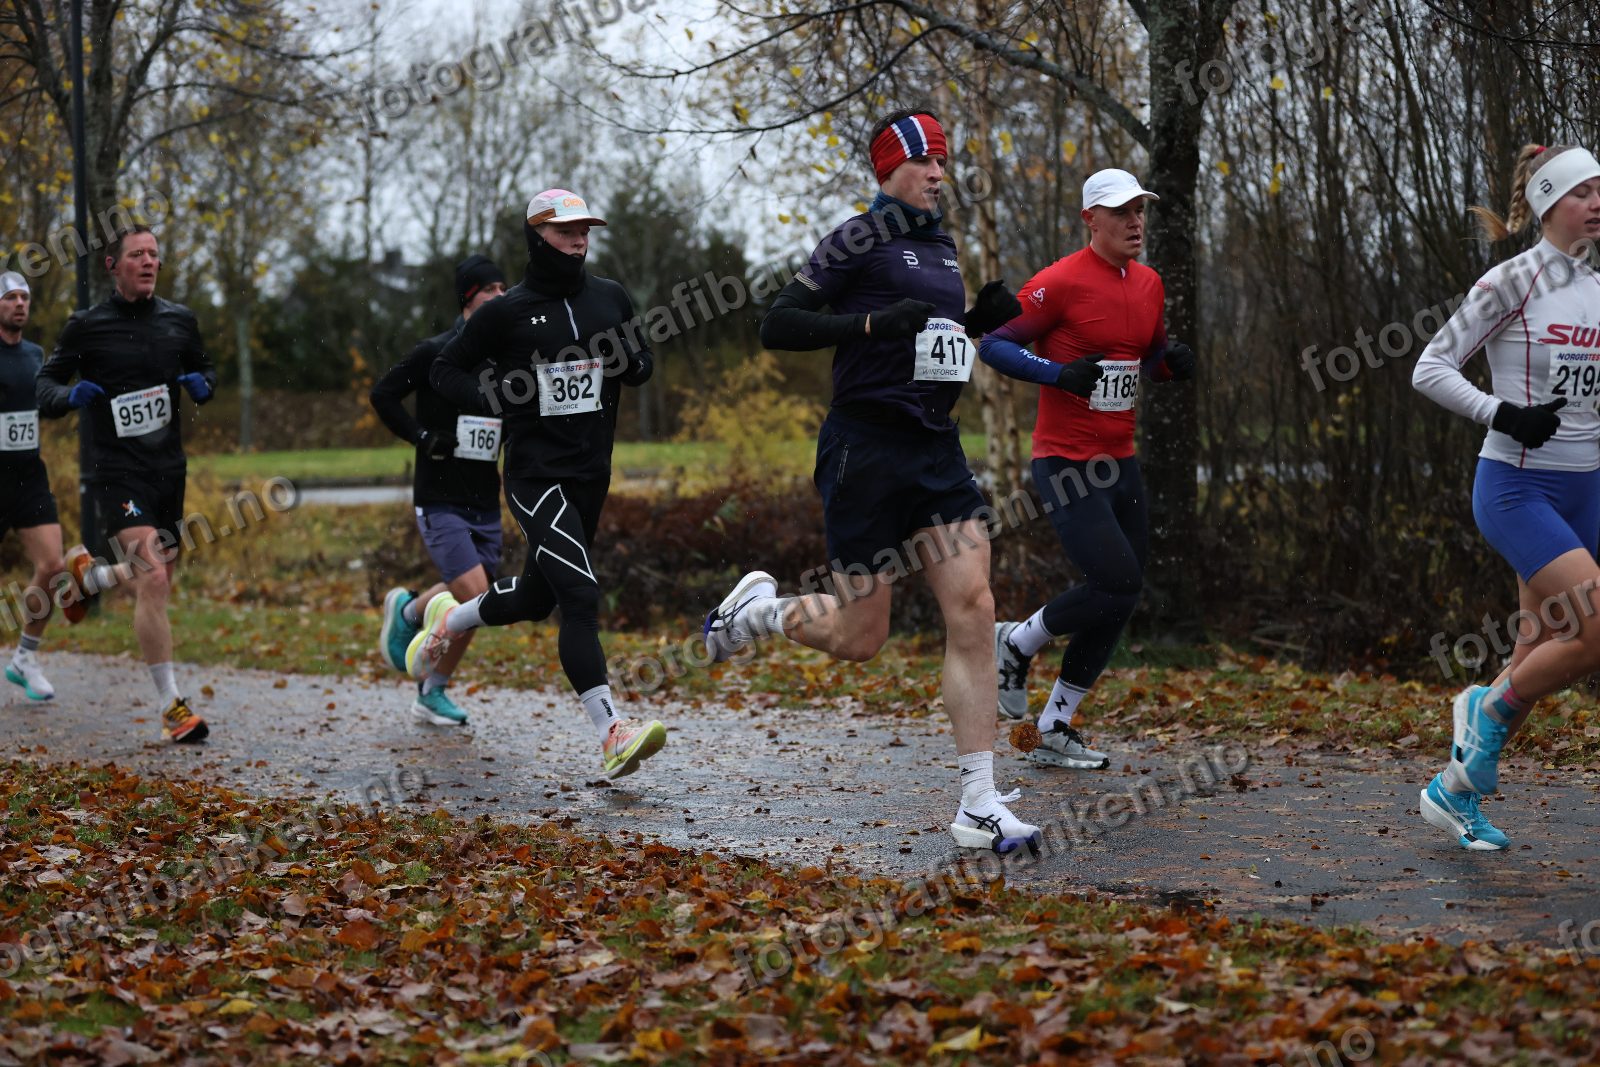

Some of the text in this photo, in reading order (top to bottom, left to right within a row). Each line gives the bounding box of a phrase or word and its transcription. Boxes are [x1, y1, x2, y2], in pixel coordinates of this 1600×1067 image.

[931, 336, 967, 366] 417
[922, 368, 959, 376] WINFORCE
[552, 373, 595, 403] 362
[1100, 373, 1138, 399] 1185
[119, 398, 167, 427] 9512
[8, 422, 35, 442] 675
[469, 428, 496, 450] 166
